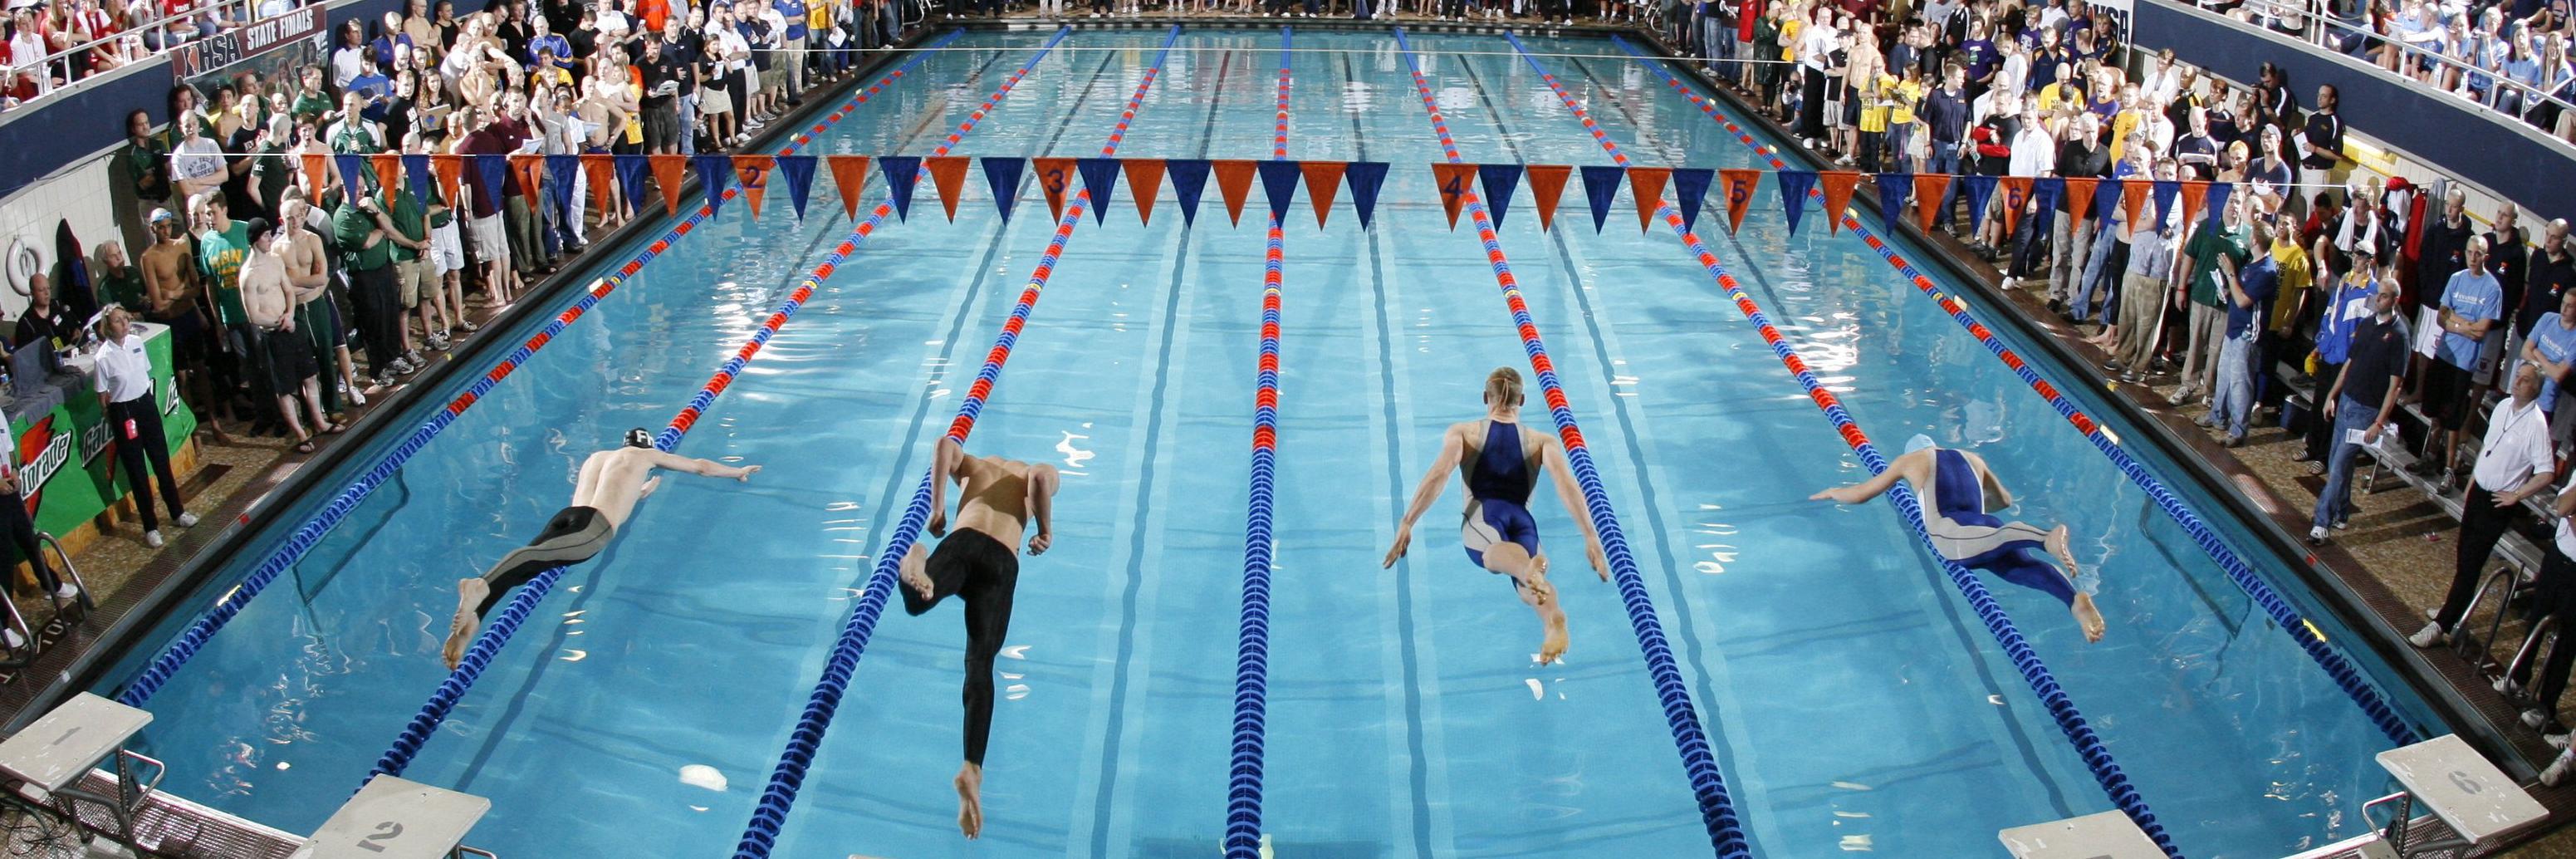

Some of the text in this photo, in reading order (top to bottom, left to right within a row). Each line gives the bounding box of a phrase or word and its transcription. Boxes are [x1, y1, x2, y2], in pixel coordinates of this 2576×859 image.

[182, 8, 314, 78] IHSA STATE FINALS
[742, 165, 766, 189] 2
[1047, 169, 1065, 195] 3
[1443, 174, 1464, 199] 4
[1730, 179, 1747, 204] 5
[2007, 187, 2022, 210] 6
[22, 430, 71, 500] torade
[2447, 770, 2483, 796] 6
[356, 821, 404, 854] 2
